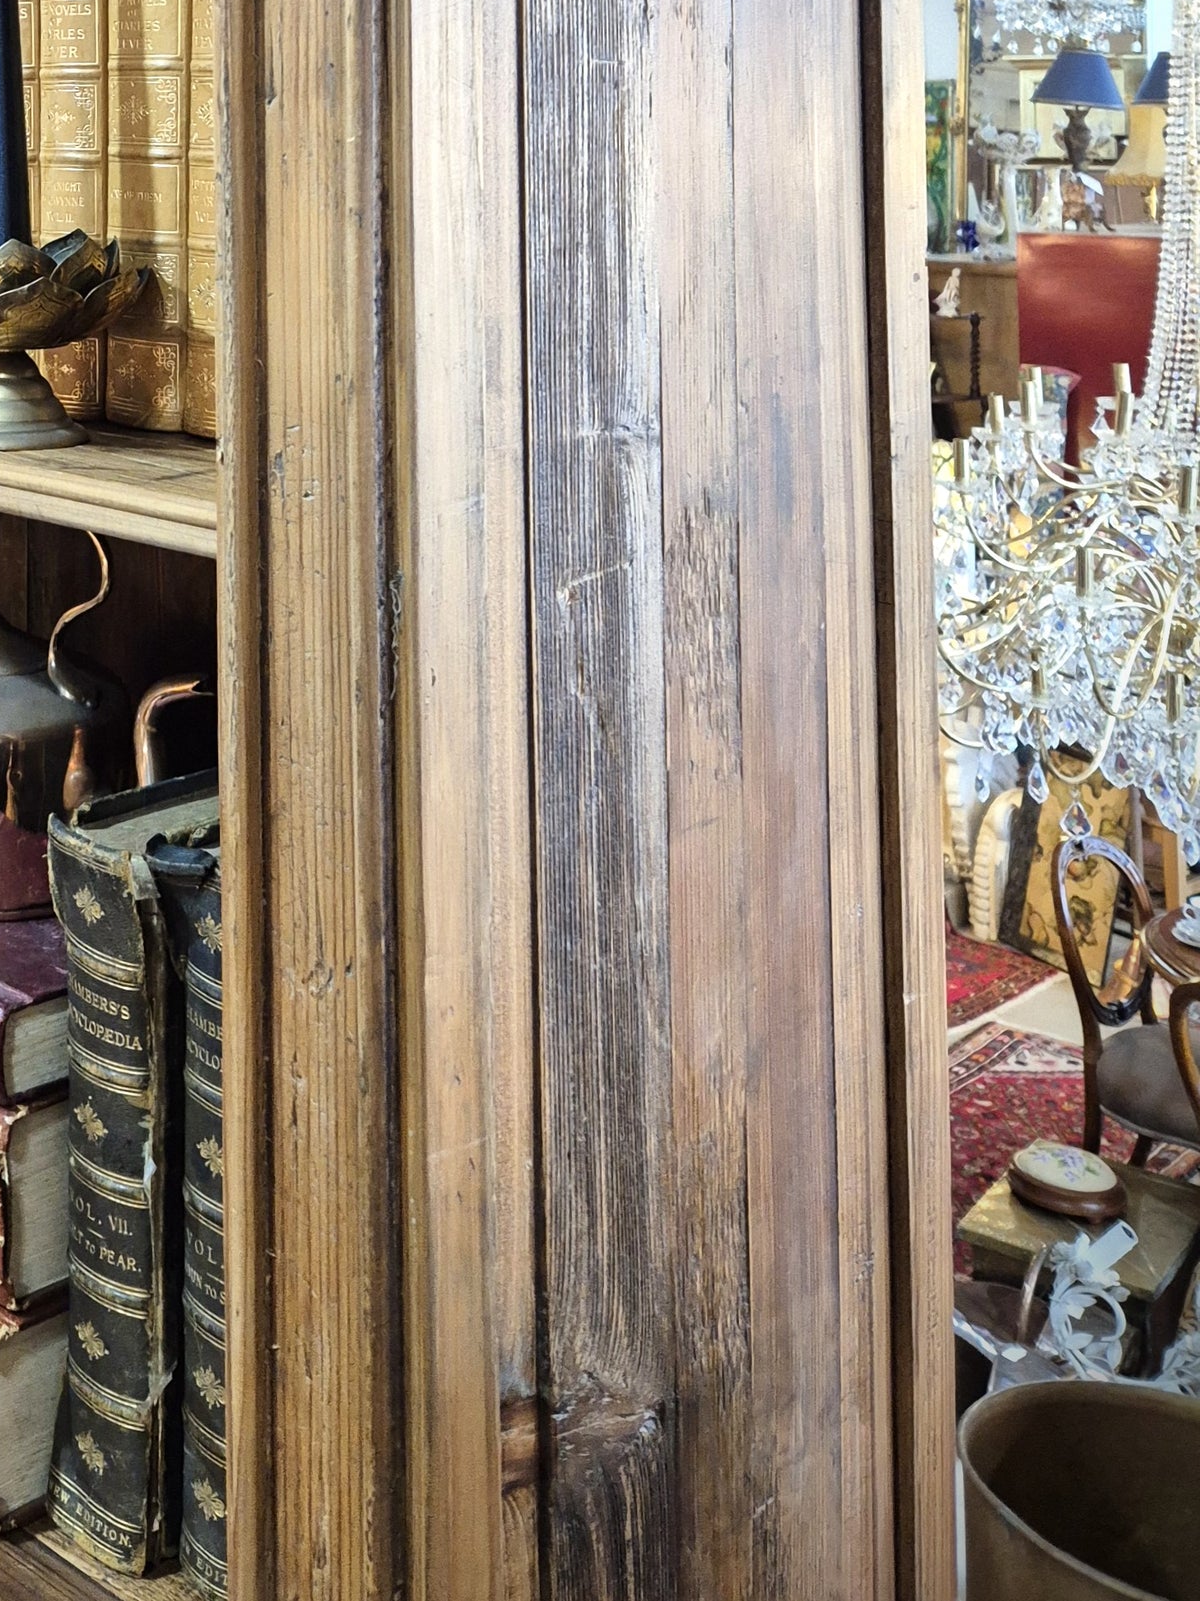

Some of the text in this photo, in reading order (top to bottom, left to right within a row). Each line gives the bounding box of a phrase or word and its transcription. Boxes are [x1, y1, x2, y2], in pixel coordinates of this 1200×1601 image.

[50, 3, 92, 16] NOVELS
[68, 971, 131, 1020] AMBERS'S
[68, 1003, 143, 1051] CYCLOPÆDIA
[108, 1213, 133, 1237] VII.
[85, 1239, 96, 1255] TO
[99, 1246, 142, 1273] PEAR.
[53, 1484, 132, 1548] EW EDITION.
[195, 1557, 227, 1586] EDIT
